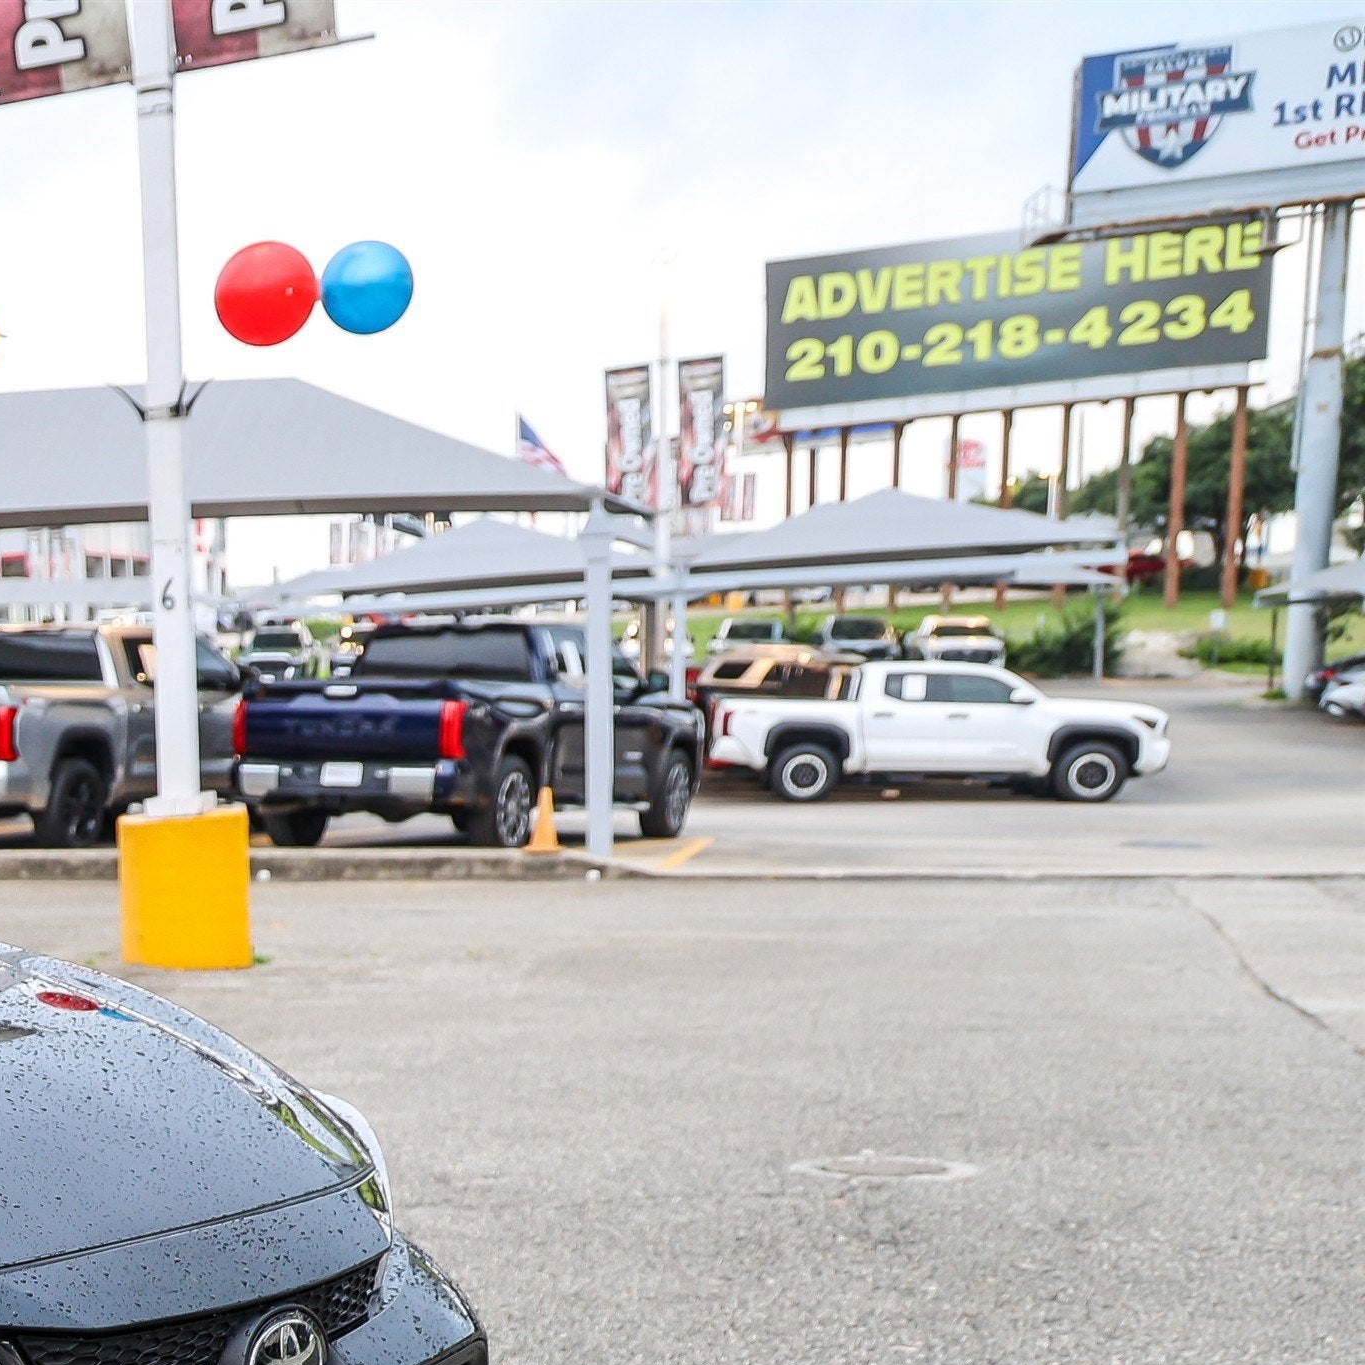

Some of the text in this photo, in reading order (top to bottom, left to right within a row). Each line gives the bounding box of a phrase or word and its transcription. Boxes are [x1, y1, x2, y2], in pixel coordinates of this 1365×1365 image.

[1102, 75, 1249, 118] MILITARY
[1273, 98, 1323, 127] 1st
[780, 219, 1265, 324] ADVERTISE HERE
[784, 288, 1256, 382] 210-218-4234
[161, 577, 175, 610] 6
